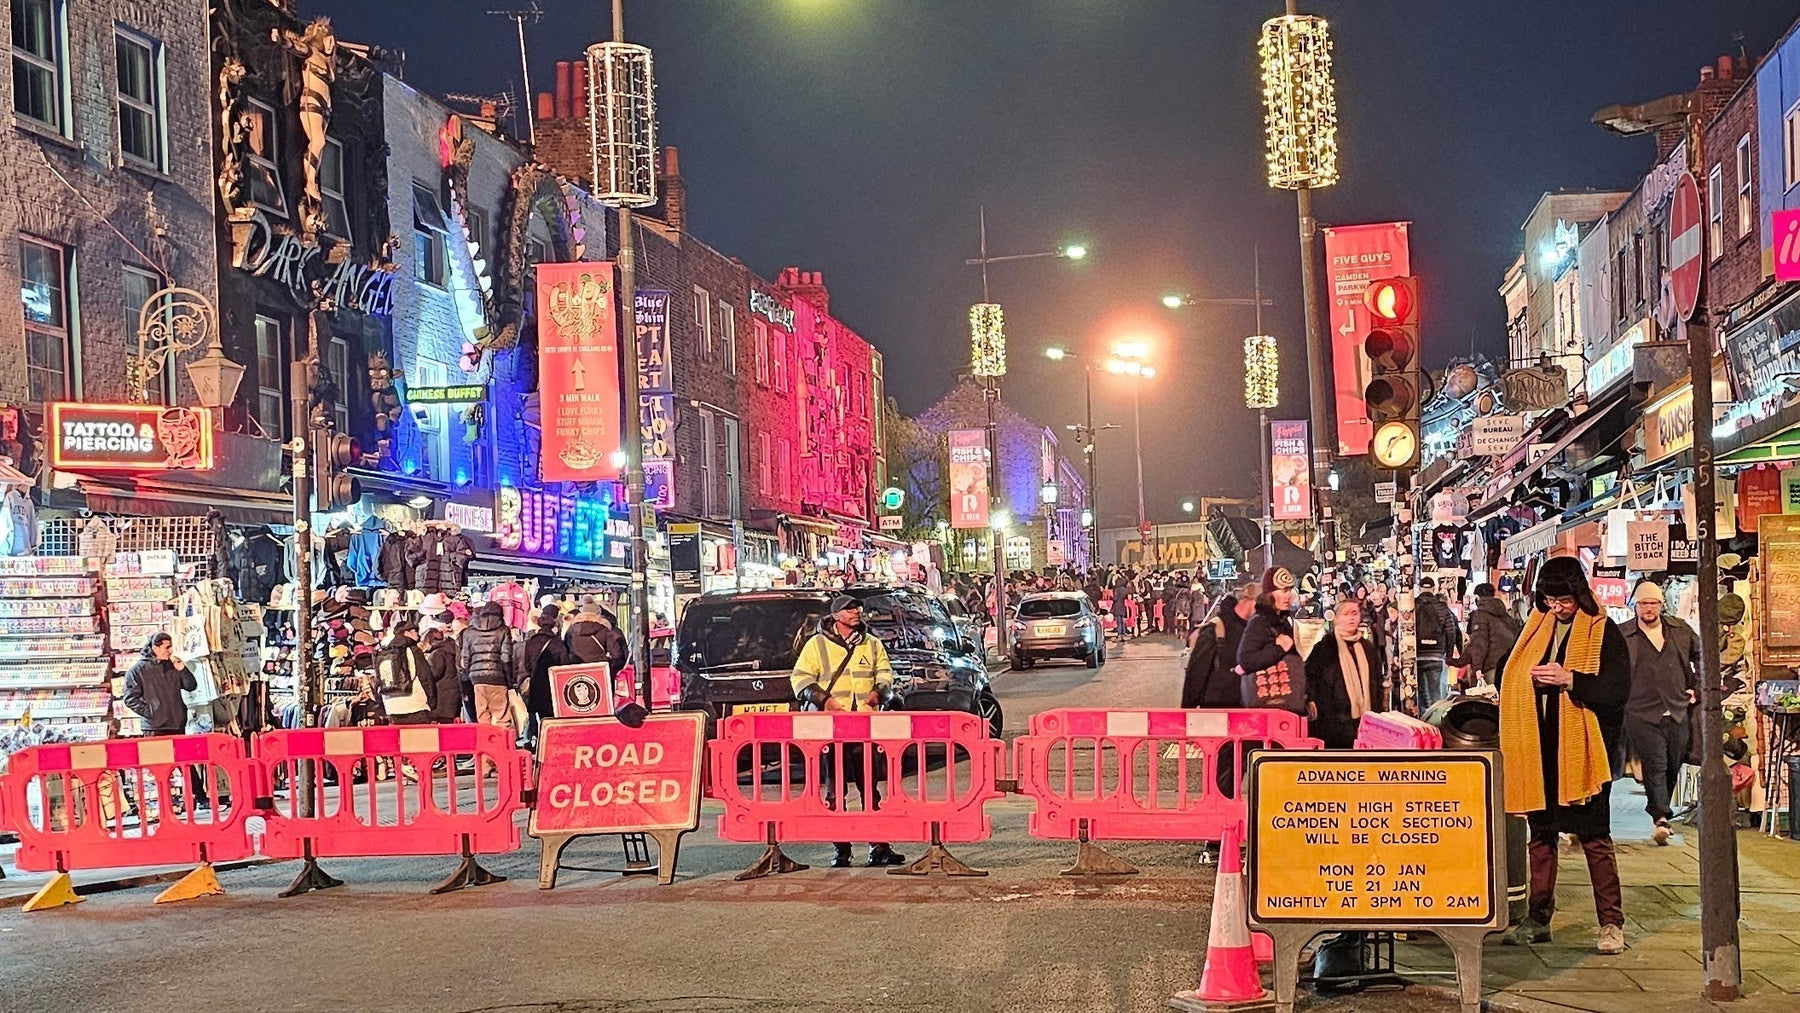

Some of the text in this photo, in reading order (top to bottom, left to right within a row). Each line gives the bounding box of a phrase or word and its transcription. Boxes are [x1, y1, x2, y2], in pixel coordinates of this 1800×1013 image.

[240, 209, 394, 319] DARK ANGEL
[1333, 252, 1391, 265] FIVE GUYS
[1335, 273, 1369, 282] CAMDEN
[635, 296, 663, 308] Blue
[406, 386, 483, 401] CHINESE BUFFET
[565, 394, 580, 402] MIN
[580, 394, 600, 402] WALK
[580, 407, 602, 415] FUNKY
[557, 417, 576, 426] STUFF
[62, 421, 155, 438] TATTOO &
[556, 427, 605, 436] FUNKY CHIPS
[63, 436, 154, 452] PIERCING
[1274, 440, 1295, 448] FISH
[952, 447, 974, 455] FISH
[1533, 449, 1548, 459] AT
[1288, 504, 1302, 512] MIN
[445, 502, 493, 533] CHINESE
[501, 484, 609, 560] BUFFET
[1640, 533, 1658, 542] THE
[1634, 542, 1664, 552] BITCH
[1635, 551, 1664, 560] IS BACK
[1671, 549, 1689, 558] NEED
[574, 742, 664, 769] ROAD
[1297, 770, 1447, 782] ADVANCE WARNING
[550, 779, 681, 809] CLOSED
[1283, 801, 1461, 813] CAMDEN HIGH STREET
[1271, 815, 1473, 829] (CAMDEN LOCK SECTION)
[1305, 832, 1440, 845] WILL BE CLOSED
[1319, 864, 1426, 876] MON 20 JAN
[1326, 880, 1420, 892] TUE 21 JAN
[1267, 896, 1480, 908] NIGHTLY AT 3PM TO 2AM
